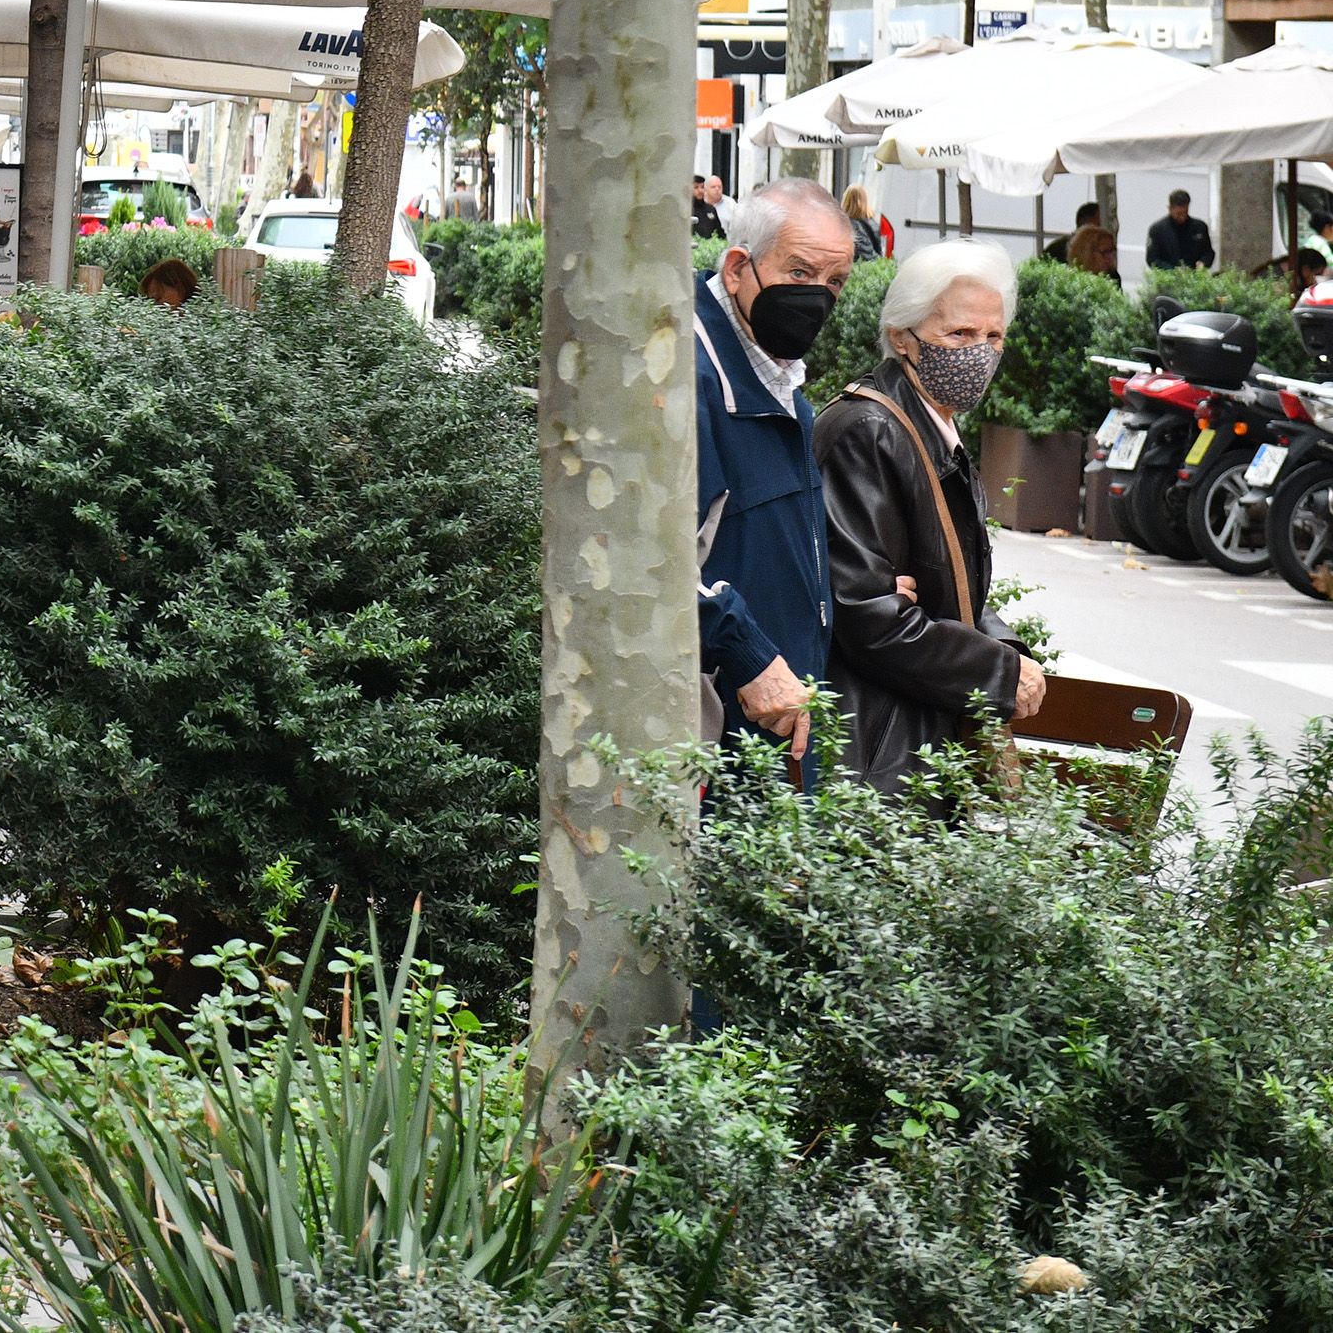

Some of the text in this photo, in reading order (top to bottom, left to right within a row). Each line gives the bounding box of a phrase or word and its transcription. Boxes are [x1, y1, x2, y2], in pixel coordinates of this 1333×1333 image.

[298, 29, 364, 58] LAVA
[696, 116, 728, 128] ange
[928, 144, 963, 158] AMB
